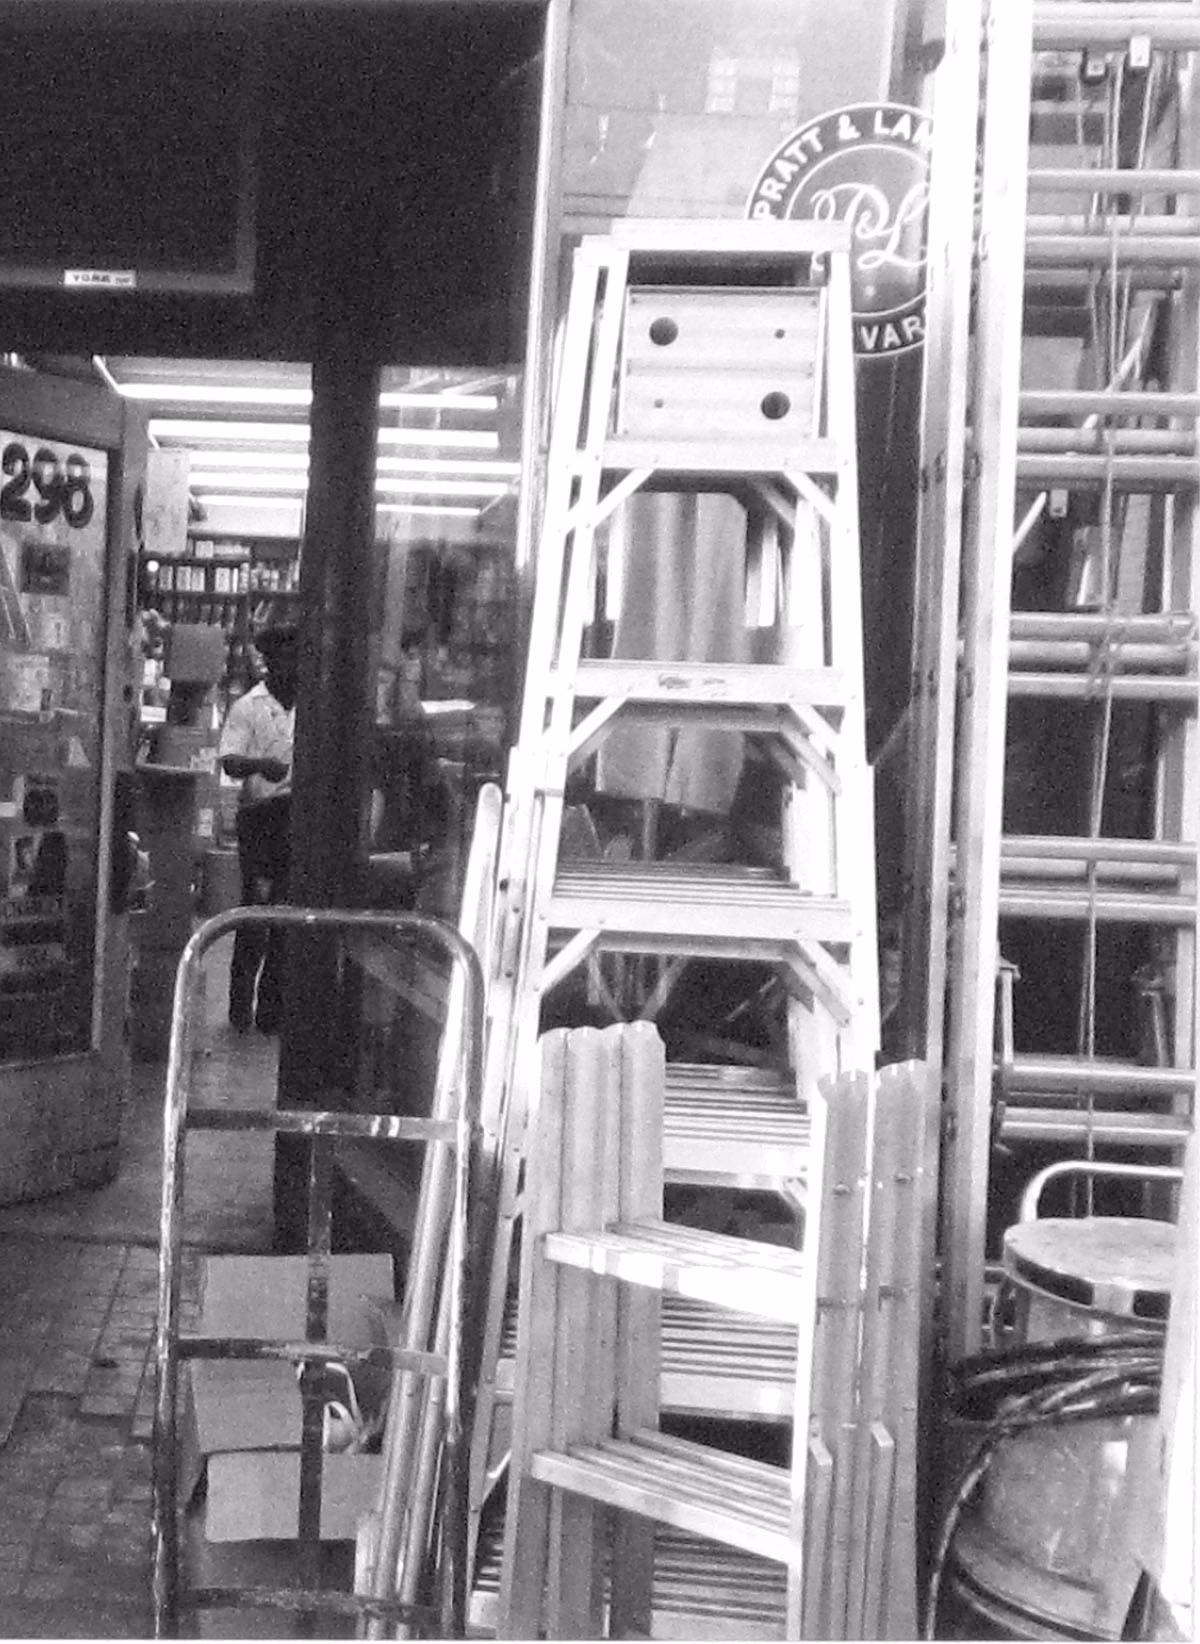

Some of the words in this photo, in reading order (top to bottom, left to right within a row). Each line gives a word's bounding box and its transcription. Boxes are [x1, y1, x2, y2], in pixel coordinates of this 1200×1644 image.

[753, 127, 823, 219] PRATT
[839, 115, 861, 140] &
[861, 316, 925, 349] VAR
[0, 443, 94, 529] 298
